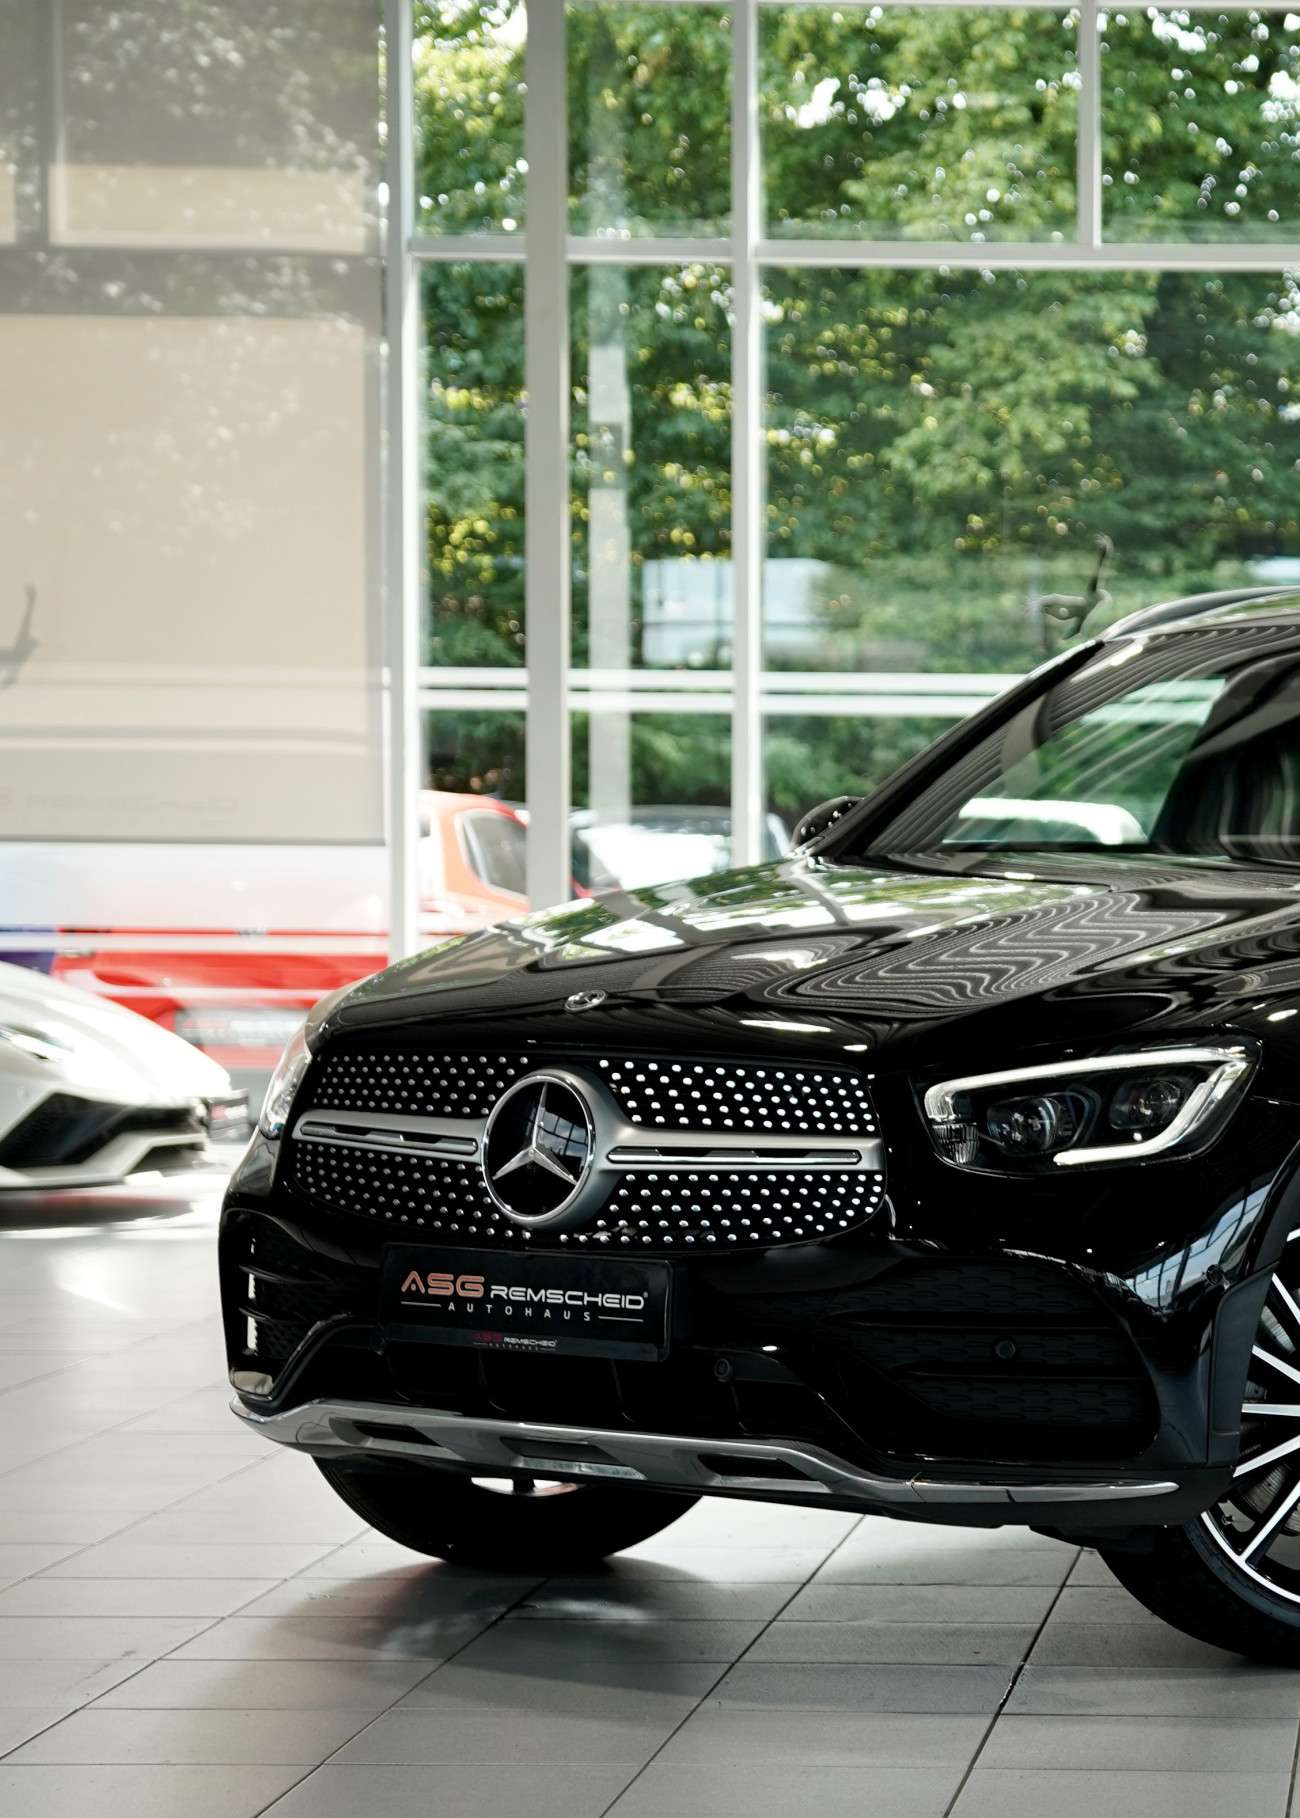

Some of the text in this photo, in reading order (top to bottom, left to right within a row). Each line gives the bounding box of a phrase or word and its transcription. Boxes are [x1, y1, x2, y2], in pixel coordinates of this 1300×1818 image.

[401, 1270, 643, 1310] ASG REMSCHEID
[448, 1302, 591, 1322] AUTOHAUS
